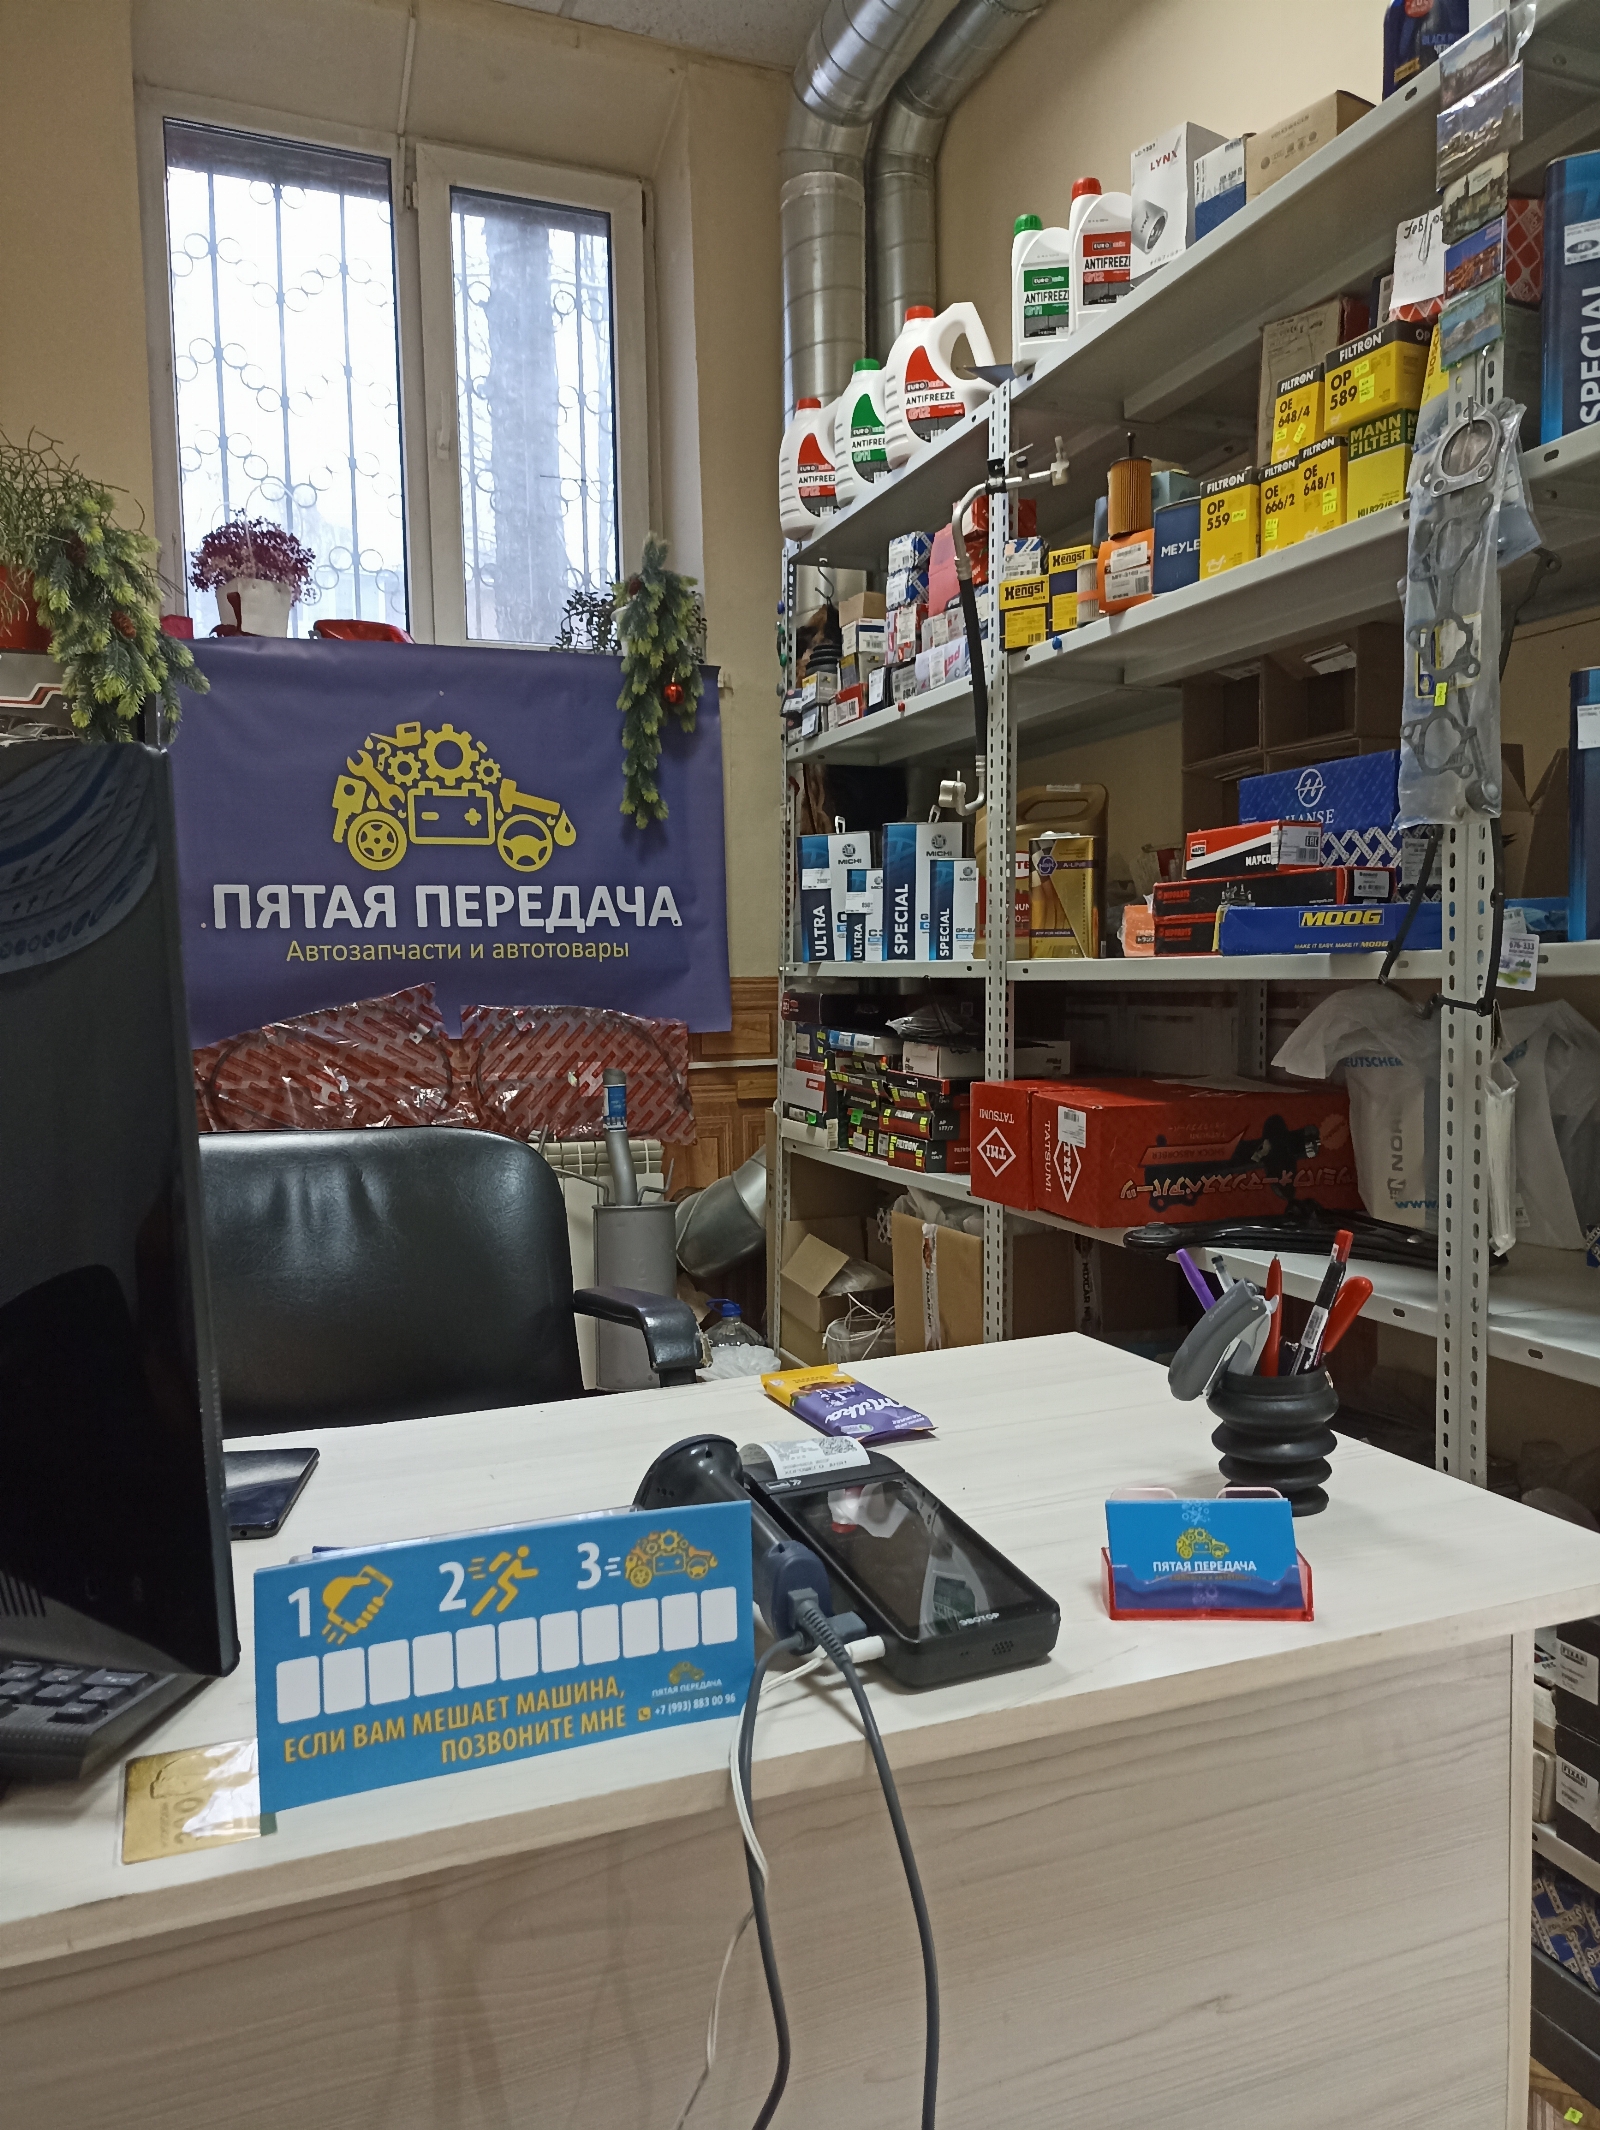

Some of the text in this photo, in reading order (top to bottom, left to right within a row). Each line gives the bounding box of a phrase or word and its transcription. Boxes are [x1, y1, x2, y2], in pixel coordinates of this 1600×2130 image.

[1149, 149, 1179, 172] LYNX
[1339, 331, 1384, 363] FILTRON
[1280, 370, 1315, 393] FILTRON
[1330, 370, 1352, 391] OP
[905, 391, 956, 406] ANTIFREEZE
[1279, 398, 1293, 414] OE
[1330, 385, 1358, 411] 589
[1278, 405, 1311, 428] 648/4
[1350, 414, 1401, 441] MANN
[1302, 437, 1335, 459] FILTRON
[1350, 430, 1401, 457] FILTER
[1264, 461, 1296, 479] FILTRON
[1303, 464, 1318, 481] OE
[1207, 473, 1246, 494] FILTRON
[1264, 485, 1279, 500] OE
[1303, 471, 1336, 497] 648/1
[1207, 500, 1225, 516] OP
[1264, 493, 1295, 515] 666/2
[1206, 513, 1231, 532] 559
[1052, 549, 1087, 567] Hengst
[1004, 579, 1046, 602] Hengst
[1245, 853, 1271, 867] MAPCO
[212, 884, 683, 934] ПЯТАЯ ПЕРЕДАЧА
[894, 883, 909, 955] SPECIAL
[1301, 910, 1382, 926] MOOG
[812, 904, 829, 957] ULTRA
[852, 923, 863, 959] ULTRA
[939, 907, 950, 957] SPECIAL
[286, 940, 630, 963] Автозапчасти и автотовары
[1360, 940, 1389, 948] MOOG
[1508, 941, 1535, 950] 676-333
[1344, 1056, 1404, 1068] EUTSCHER
[979, 1108, 1015, 1125] TATSUMI
[895, 1139, 919, 1152] FILTRON
[985, 1143, 1008, 1161] TMI
[1044, 1120, 1052, 1193] TATSUMI
[1151, 1149, 1195, 1160] ABSORBER
[1062, 1140, 1072, 1185] TMI
[825, 1397, 904, 1424] Milka
[1152, 1560, 1258, 1573] ПЯТАЯ ПЕРЕДАЧА
[288, 1542, 602, 1637] 1 2 3
[958, 1612, 1000, 1627] ЭВОТОР
[651, 1678, 723, 1697] ПЯТАЯ ПЕРЕДАЧА
[654, 1692, 736, 1716] +7 (993) 883 00 96
[284, 1676, 626, 1763] ЕСЛИ ВАМ МЕШАЕТ МАШИНА,
[441, 1705, 626, 1763] ПОЗВОНИТЕ МНЕ
[1563, 1763, 1587, 1784] FIXAR
